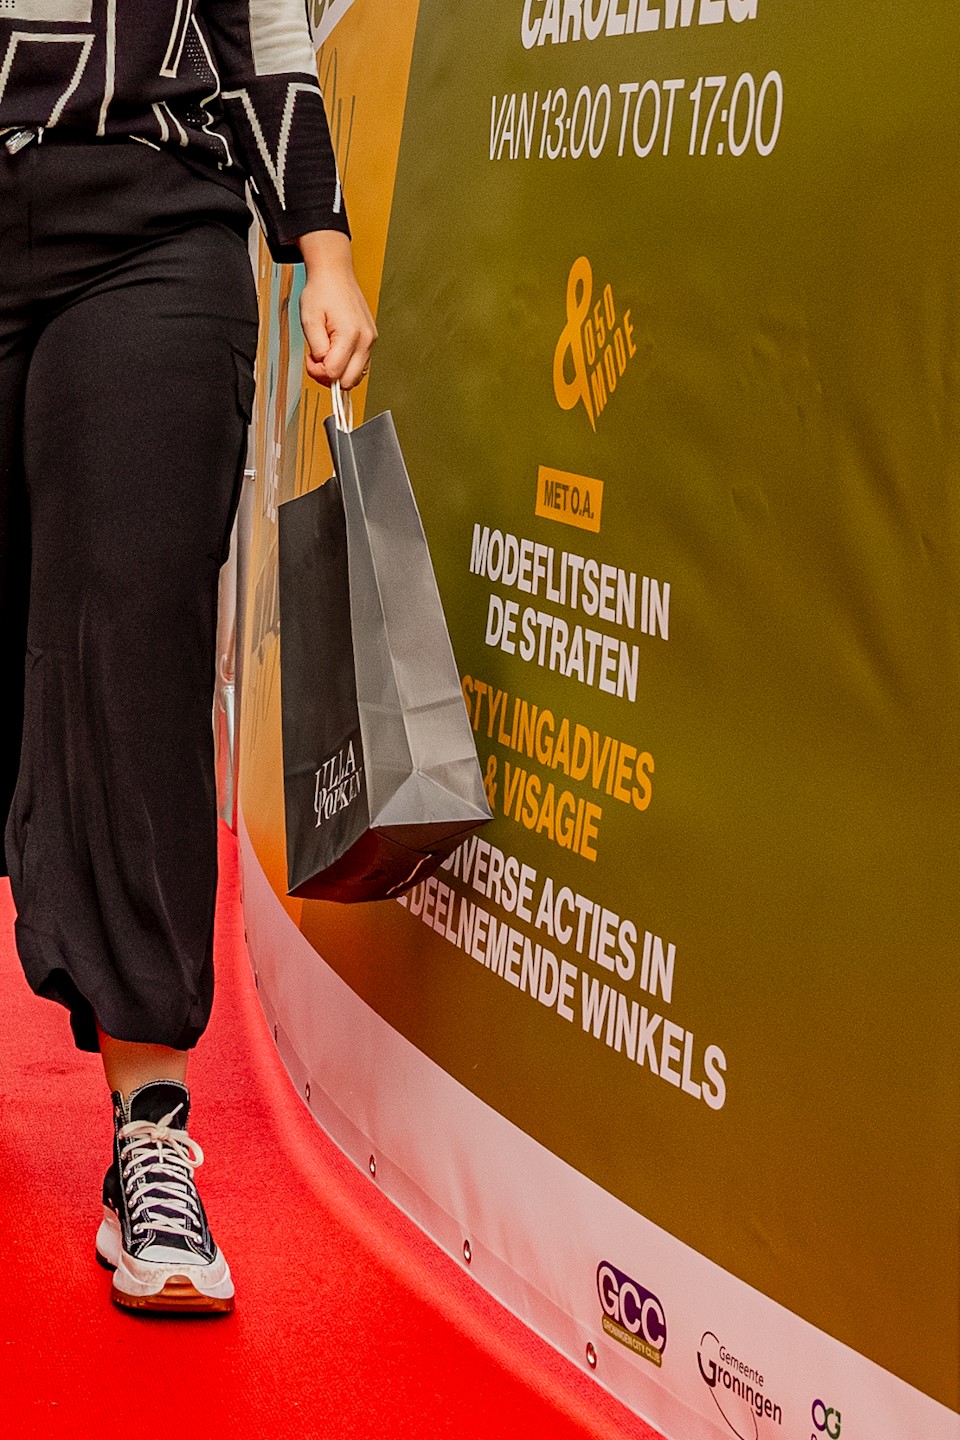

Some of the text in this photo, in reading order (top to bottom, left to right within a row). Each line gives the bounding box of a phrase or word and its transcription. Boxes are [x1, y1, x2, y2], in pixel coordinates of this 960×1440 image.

[489, 70, 783, 160] VAN 13:00 TOT 17:00
[591, 308, 637, 418] MODE
[543, 479, 595, 519] MET O.A.
[469, 523, 671, 641] MODEFLITSEN IN
[485, 593, 640, 703] DE STRATEN
[503, 761, 603, 863] VISAGIE
[535, 877, 637, 982] ACTIES
[640, 930, 677, 1004] IN
[581, 971, 728, 1111] WINKELS
[598, 1266, 665, 1350] GCC
[697, 1350, 782, 1426] Groningen
[719, 1345, 765, 1388] Gemeente
